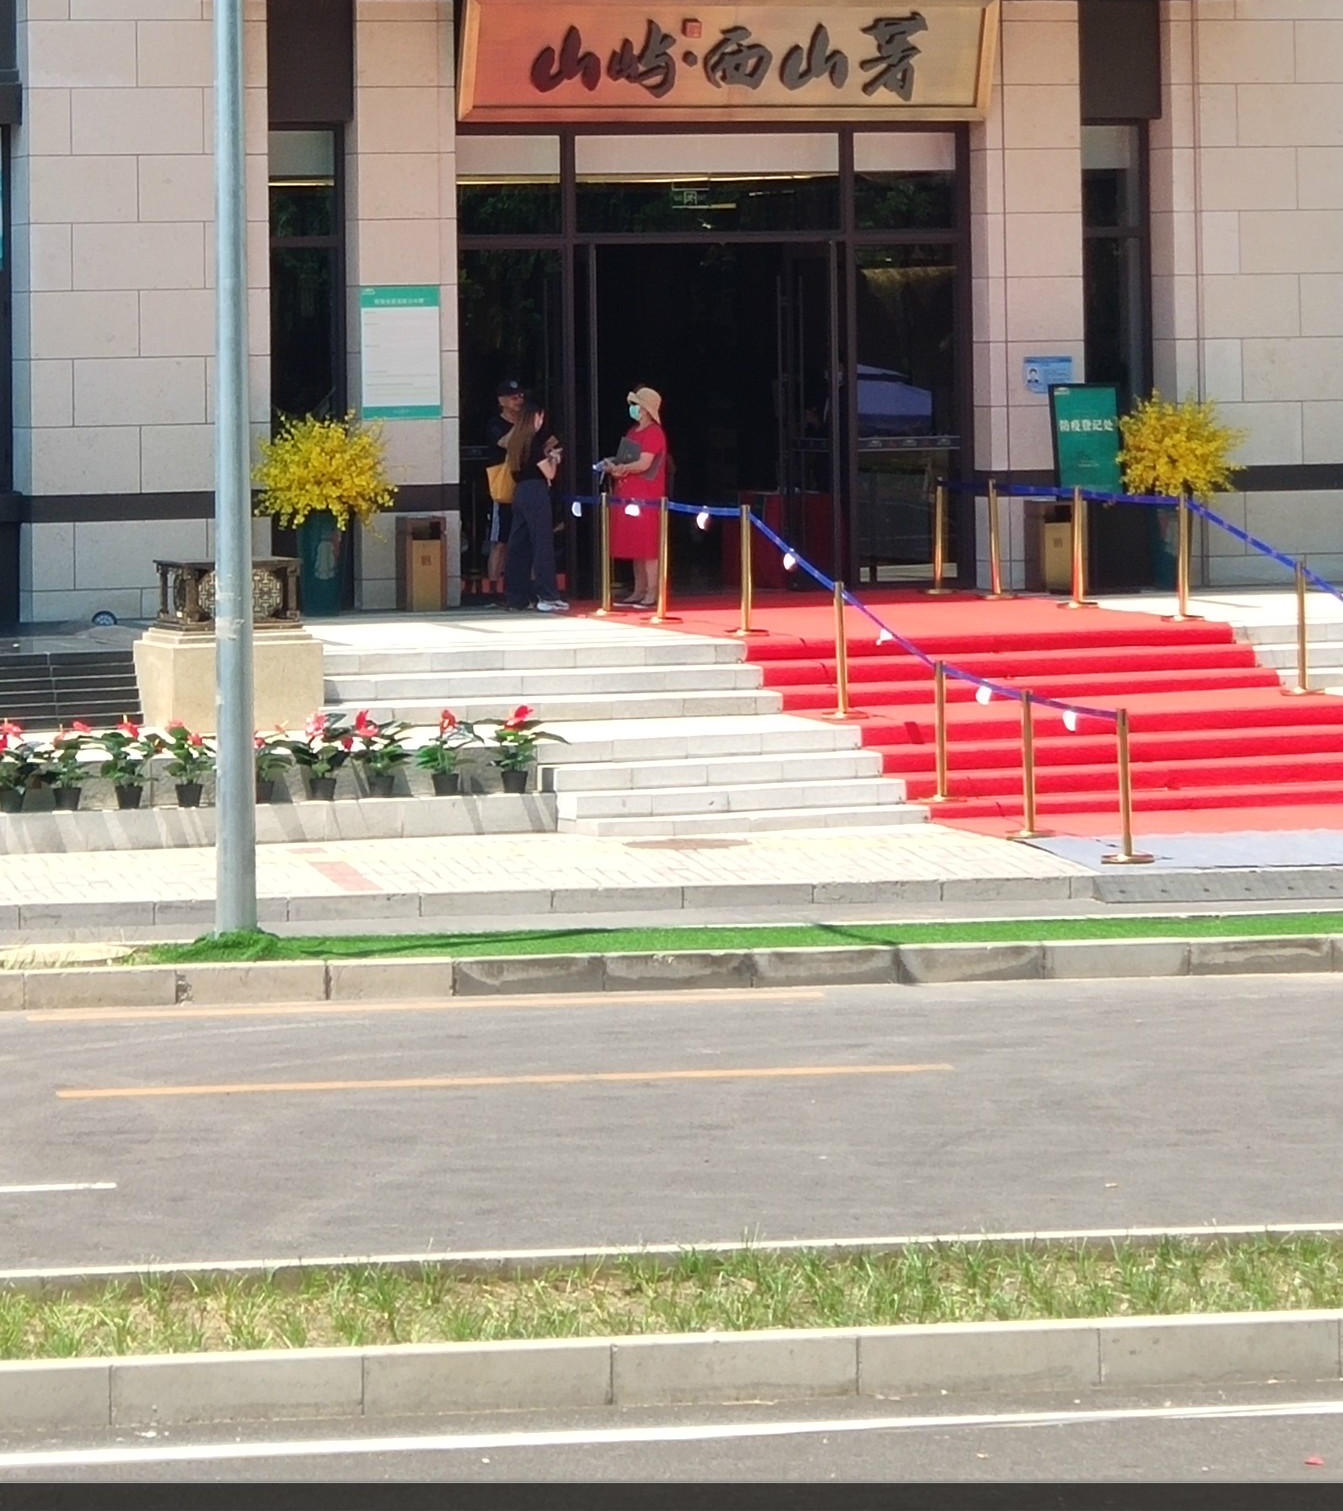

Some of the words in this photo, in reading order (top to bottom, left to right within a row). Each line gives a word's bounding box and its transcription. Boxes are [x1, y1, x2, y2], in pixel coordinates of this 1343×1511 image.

[1059, 419, 1114, 432] 防疫登记处
